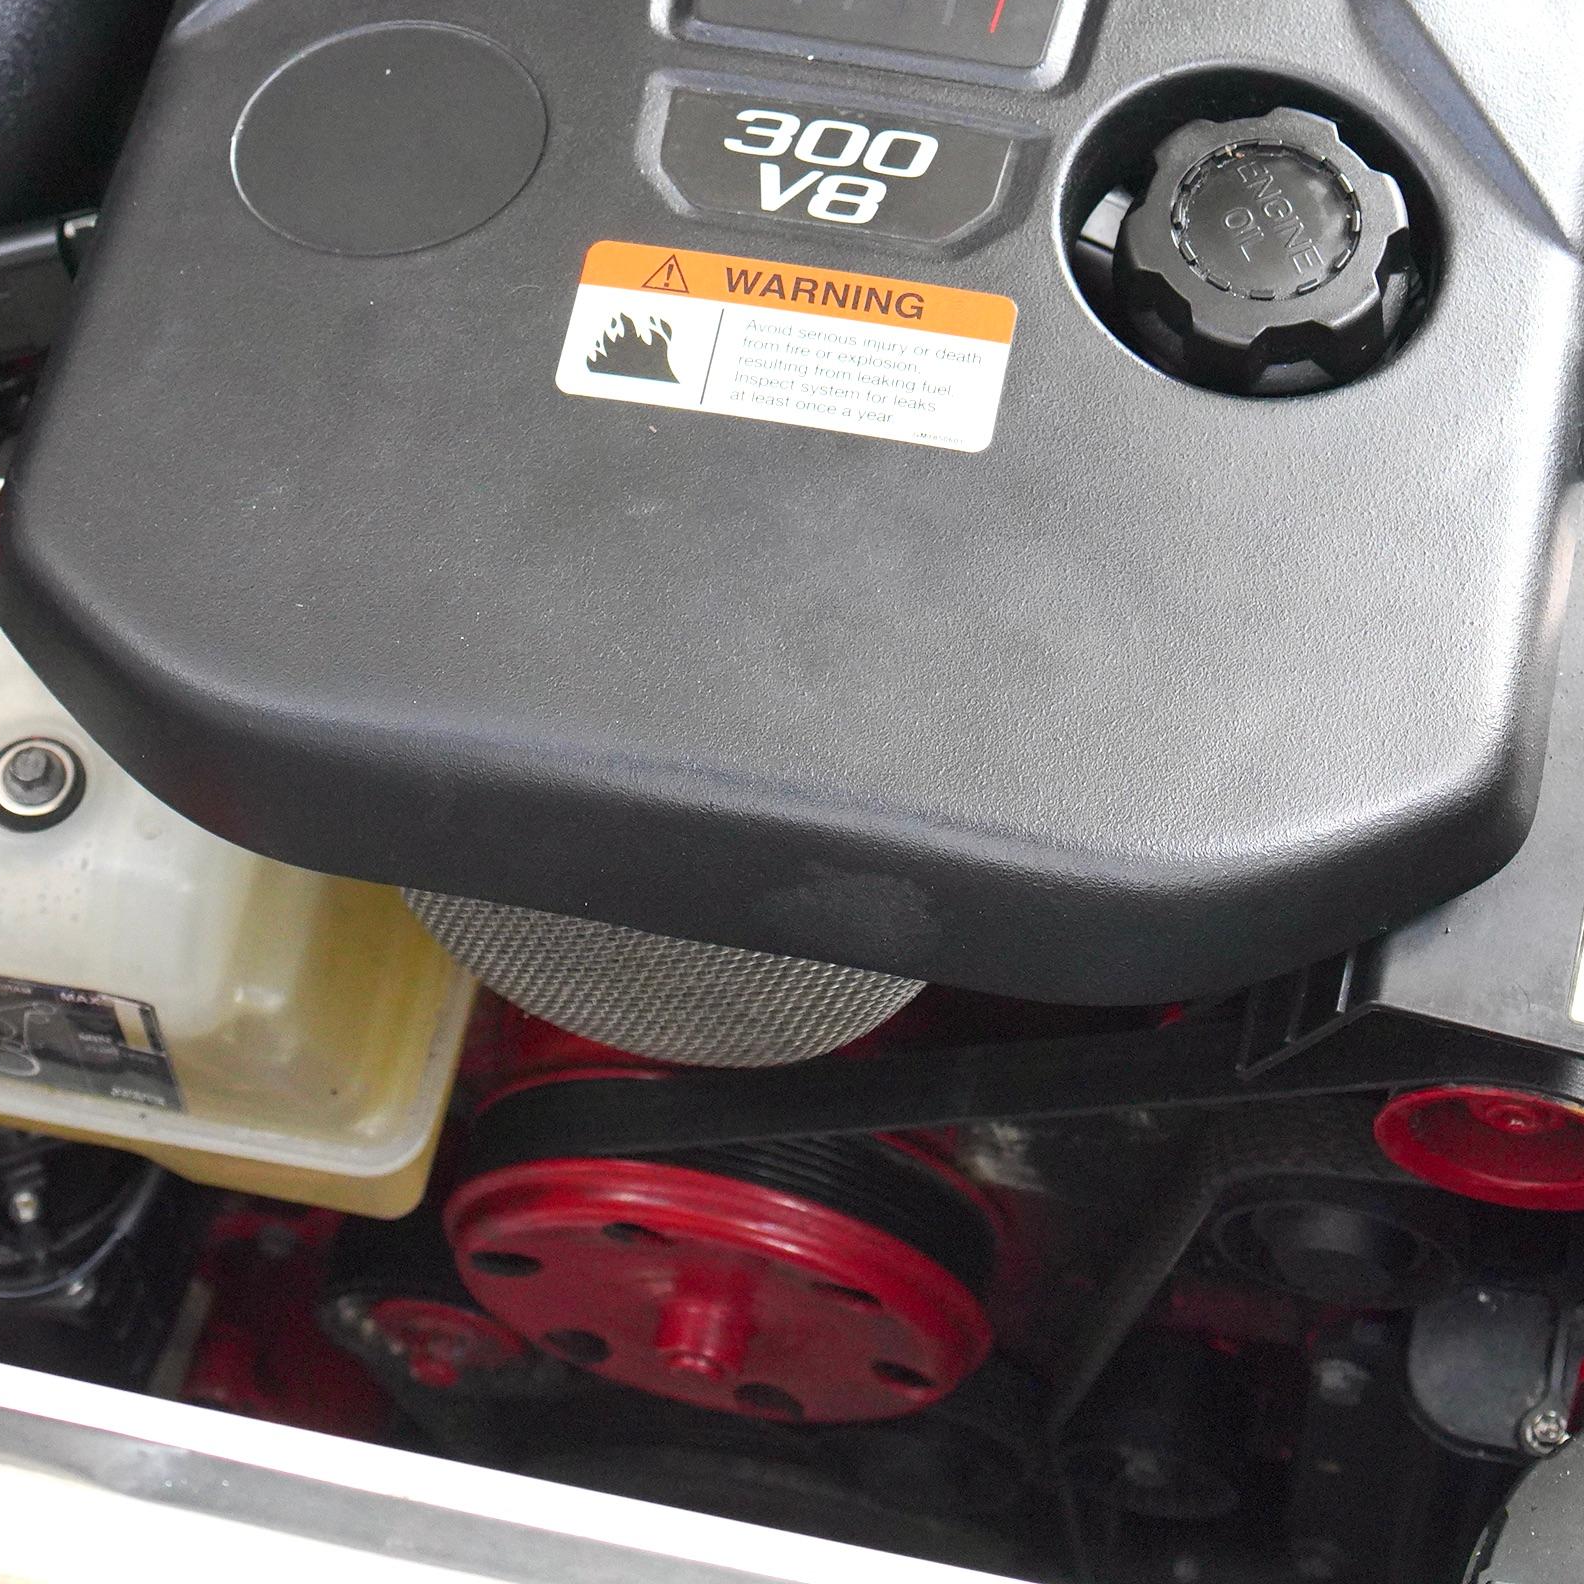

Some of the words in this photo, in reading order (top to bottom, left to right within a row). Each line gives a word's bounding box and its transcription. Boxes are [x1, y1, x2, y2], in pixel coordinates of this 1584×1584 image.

[723, 109, 939, 178] 300
[758, 164, 888, 224] V8
[1236, 161, 1325, 273] ENGINE
[1225, 206, 1264, 262] OIL
[724, 266, 926, 322] WARNING
[743, 336, 780, 353] from
[786, 342, 811, 357] fire
[816, 349, 833, 360] or
[746, 319, 793, 337] Avoid
[798, 326, 857, 346] serious
[863, 337, 908, 356] injury
[913, 344, 930, 356] or
[935, 348, 982, 365] death
[734, 371, 795, 392] Inspect
[800, 381, 860, 400] system
[866, 390, 888, 405] for
[893, 396, 937, 413] leaks
[738, 355, 809, 377] resulting
[814, 365, 852, 382] from
[857, 372, 916, 393] leaking
[730, 390, 746, 402] at
[751, 392, 791, 408] least
[795, 399, 837, 415] once
[842, 406, 852, 417] a
